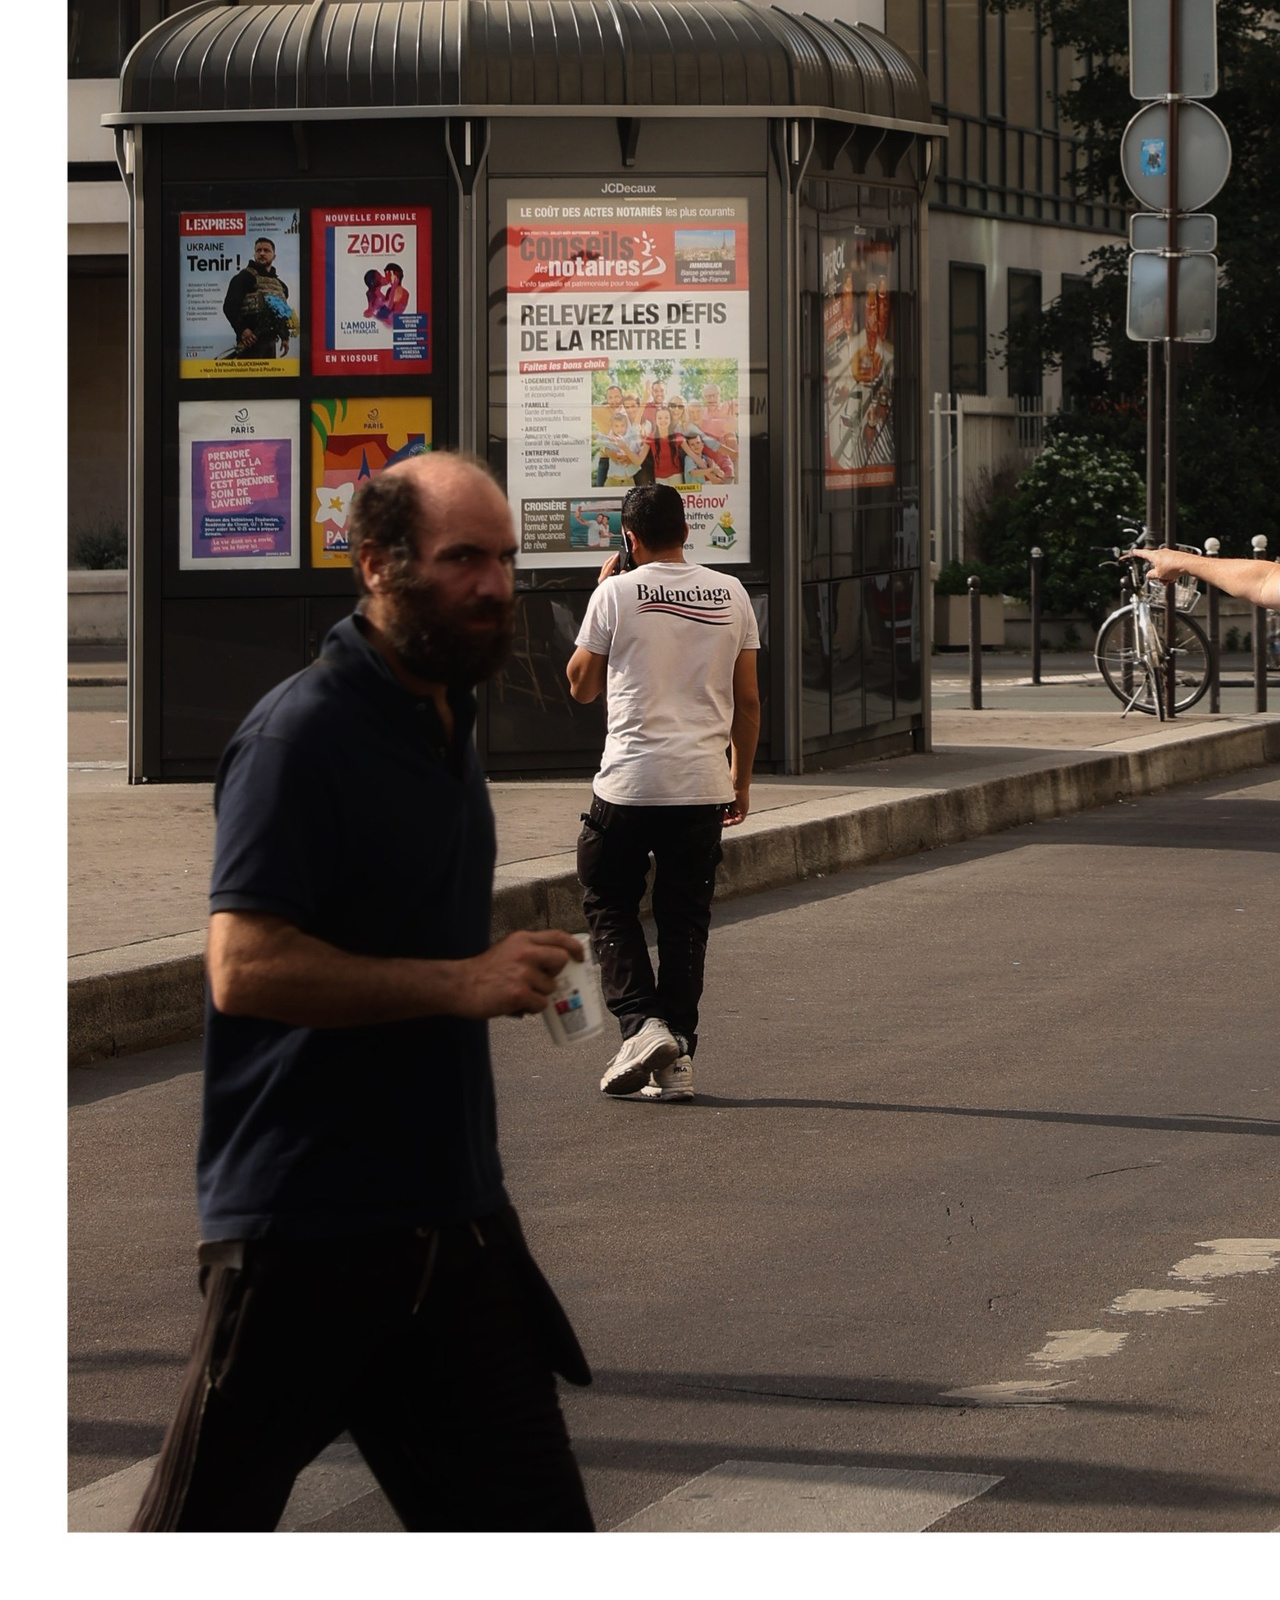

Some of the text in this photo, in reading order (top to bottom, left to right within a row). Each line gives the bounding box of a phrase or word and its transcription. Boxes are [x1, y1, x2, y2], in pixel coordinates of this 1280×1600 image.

[601, 183, 657, 193] JCDecaux
[326, 212, 416, 222] NOUVELLE FORMULE
[520, 204, 735, 219] LE COÛT DES ACTES NOTARIÉS les plus courants
[186, 242, 224, 251] UKRAINE
[348, 233, 405, 254] ZADIG
[520, 230, 634, 262] conseils
[187, 254, 241, 272] Tenir !
[534, 257, 641, 277] des notaires
[700, 269, 730, 278] généralisée
[520, 280, 536, 288] L'info
[572, 281, 609, 289] patrimoniale
[521, 299, 727, 326] RELEVEZ LES DÉFIS
[340, 321, 376, 330] L'AMOUR
[521, 325, 701, 352] DE LA RENTRÉE !
[326, 354, 379, 363] EN KIOSQUE
[524, 360, 606, 372] Faites les bons choix
[556, 376, 584, 384] ÉTUDIANT
[230, 426, 255, 434] PARIS
[208, 449, 251, 461] PRENDRE
[209, 458, 262, 471] SOIN DE LA
[210, 475, 275, 490] C'EST PRENDRE
[211, 488, 249, 500] SOIN DE
[211, 497, 254, 509] L'AVENIR.
[524, 500, 567, 512] CROISIÈRE
[524, 513, 565, 522] Trouvez votre
[524, 523, 564, 532] formule pour
[524, 532, 536, 541] des
[524, 541, 548, 550] de rêve
[636, 584, 732, 605] Balenciaga
